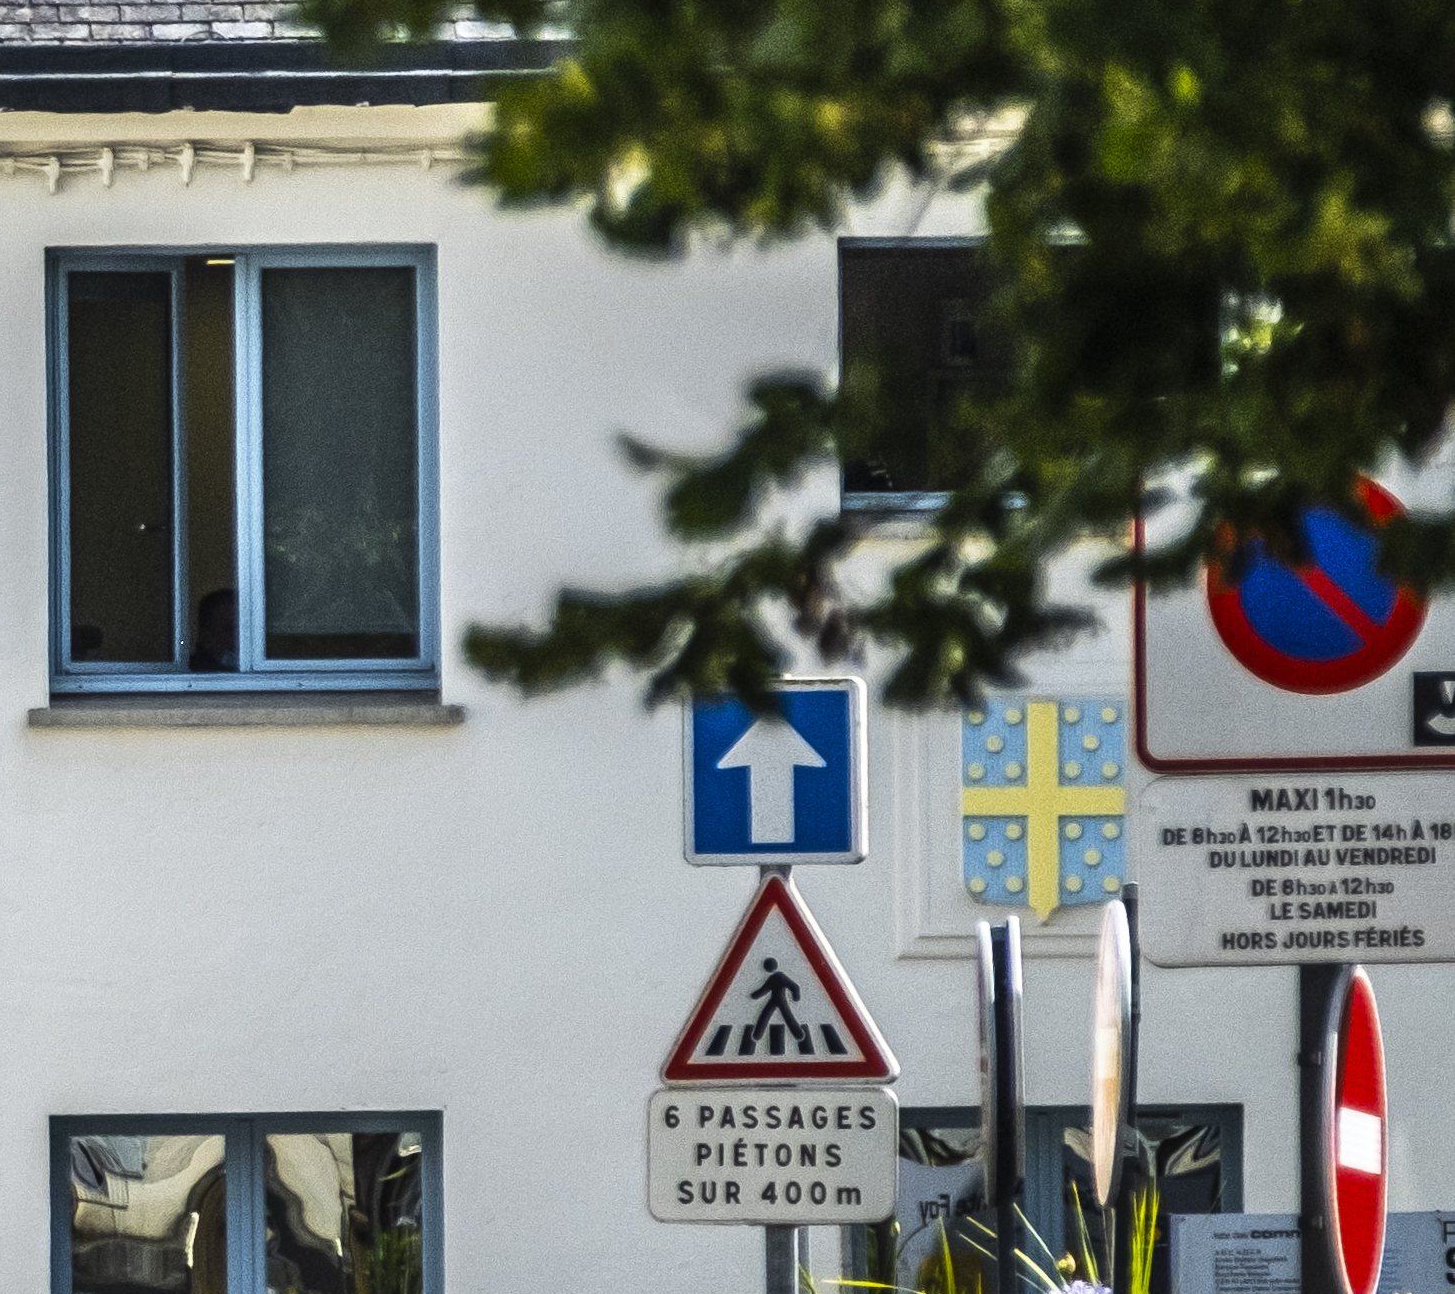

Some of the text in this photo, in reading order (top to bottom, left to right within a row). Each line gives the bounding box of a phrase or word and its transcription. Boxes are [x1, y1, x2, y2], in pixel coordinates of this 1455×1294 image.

[1250, 787, 1377, 812] MAXI 1h30
[1161, 827, 1188, 846] DE
[1191, 827, 1236, 845] 8h30
[1238, 823, 1253, 844] À
[1256, 825, 1312, 844] 12h30
[1313, 824, 1337, 843] ET
[1341, 824, 1368, 843] DE
[1371, 822, 1408, 842] 14h
[1411, 819, 1427, 841] À
[1209, 846, 1439, 869] DU LUNDI AU VENDREDI
[1250, 879, 1278, 897] DE
[1282, 878, 1327, 896] 8h30
[1341, 877, 1396, 896] 12h30
[1269, 901, 1379, 921] LE SAMEDI
[1221, 926, 1427, 951] HORS JOURS FÉRIÉS
[664, 1105, 877, 1130] 6 PASSAGES
[696, 1137, 842, 1168] PIÉTONS
[677, 1180, 741, 1205] SUR
